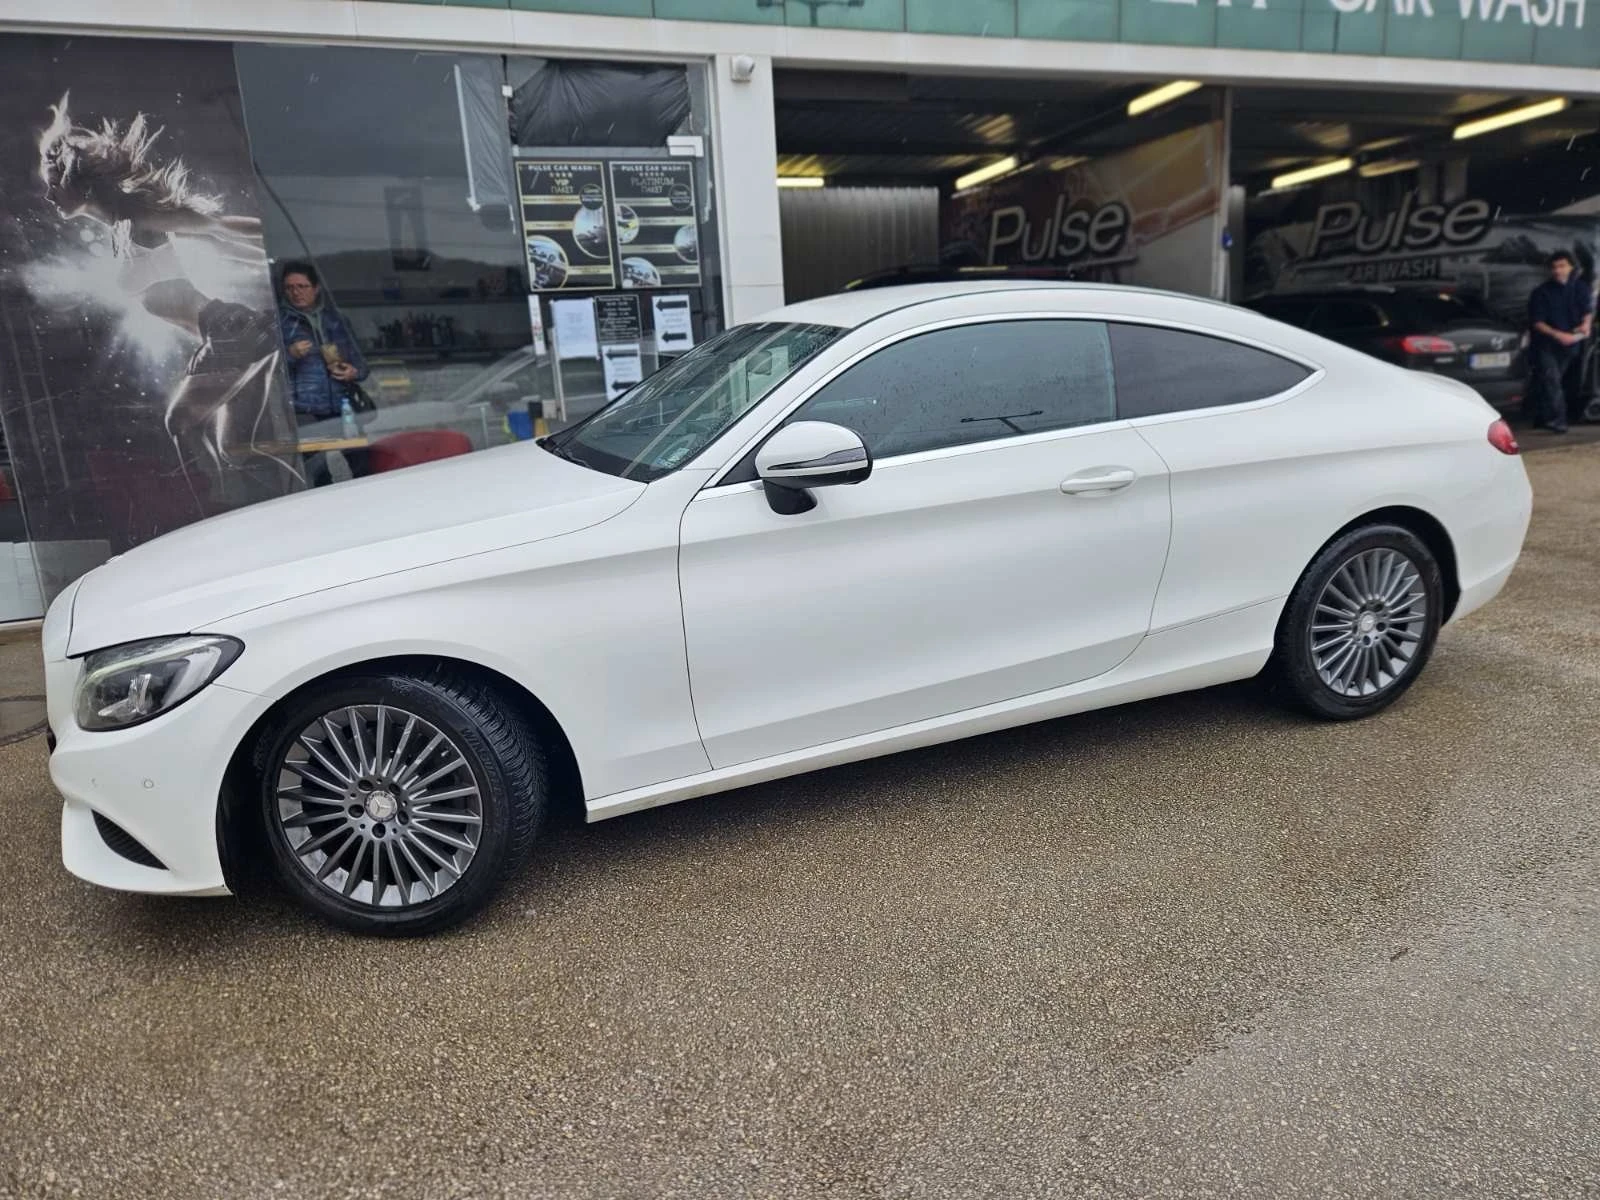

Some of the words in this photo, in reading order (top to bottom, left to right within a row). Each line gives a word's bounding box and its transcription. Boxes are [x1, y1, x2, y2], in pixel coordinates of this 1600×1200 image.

[987, 194, 1126, 266] Pulse
[1307, 193, 1490, 259] Pulse
[1378, 258, 1438, 281] WASH
